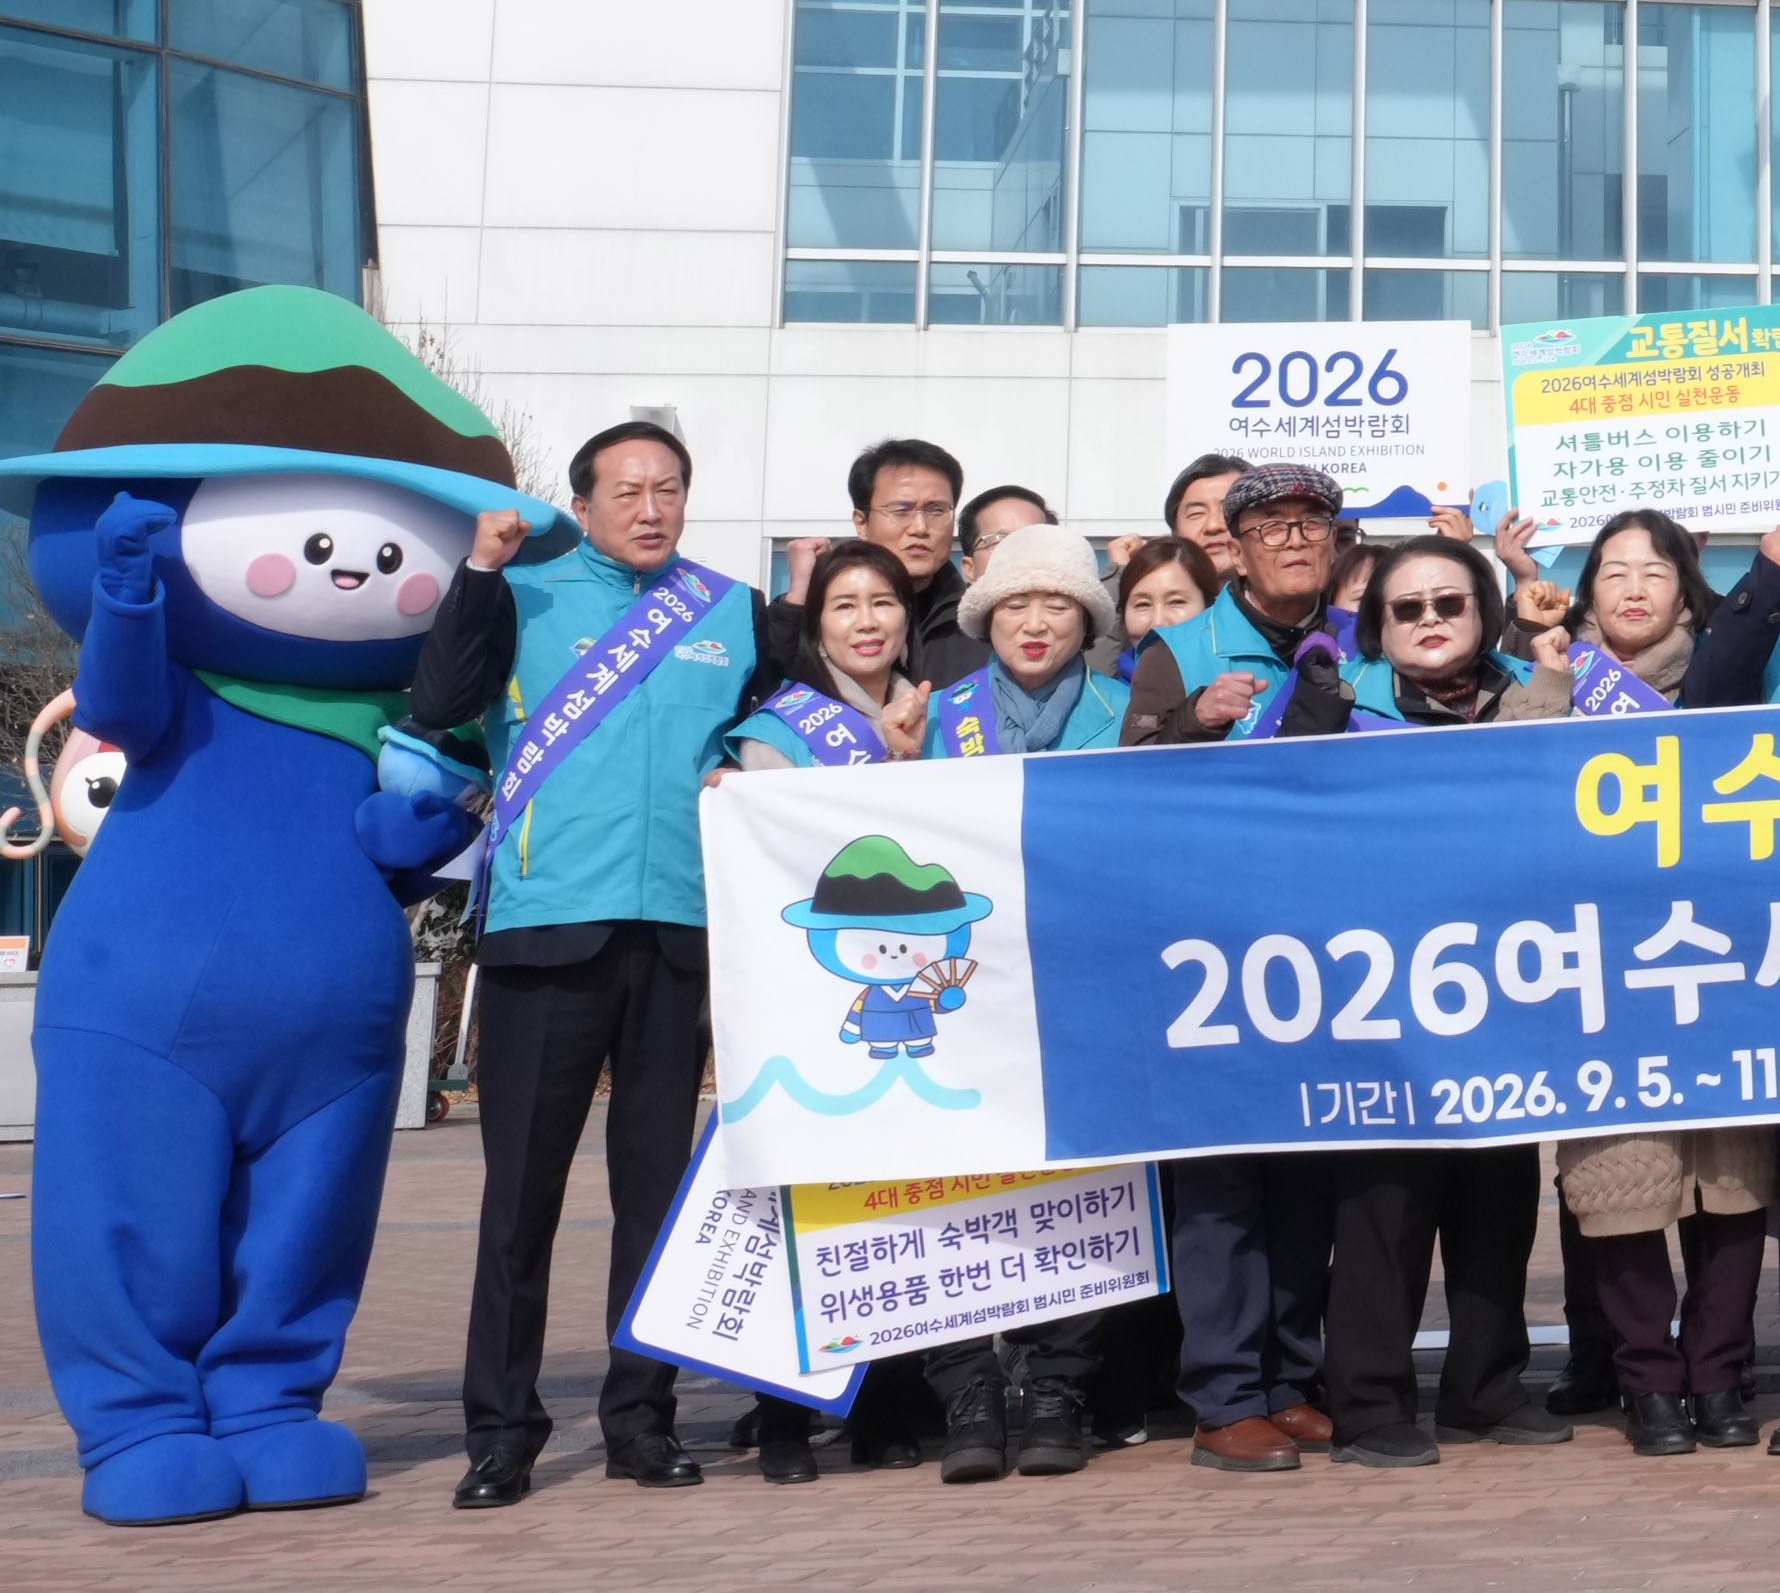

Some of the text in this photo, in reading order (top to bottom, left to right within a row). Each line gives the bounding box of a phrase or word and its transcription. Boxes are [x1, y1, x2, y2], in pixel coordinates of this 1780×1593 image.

[1625, 316, 1749, 359] 교통질서
[1231, 348, 1409, 408] 2026
[1541, 361, 1765, 394] 2026여수세계섬박람회 성공개최
[1569, 384, 1741, 416] 4대 중점 시민 실천운동
[1229, 413, 1410, 439] 여수세계섬박람회
[1555, 418, 1766, 453] 셔틀버스 이용하기
[1248, 446, 1295, 459] WORLD
[1299, 444, 1346, 457] ISLAND
[1350, 443, 1425, 456] EXHIBITION
[1321, 462, 1367, 474] KOREA
[1553, 444, 1771, 480] 자가용 이용 줄이기
[1689, 474, 1727, 496] 질서
[1702, 501, 1736, 517] 범시민
[502, 586, 696, 803] 2026 여수세계섬박람회
[1584, 668, 1622, 710] 2026
[799, 703, 844, 735] 2026
[864, 1185, 900, 1211] 4대
[904, 1177, 944, 1205] 중점
[816, 1181, 1136, 1277] 친절하게 숙박객 맞이하기
[686, 1228, 739, 1331] EXHIBITION
[819, 1226, 1140, 1324] 위생용품 한번 더 확인하기
[869, 1270, 1151, 1346] 2026여수세계섬박람회 범시민 준비위원회
